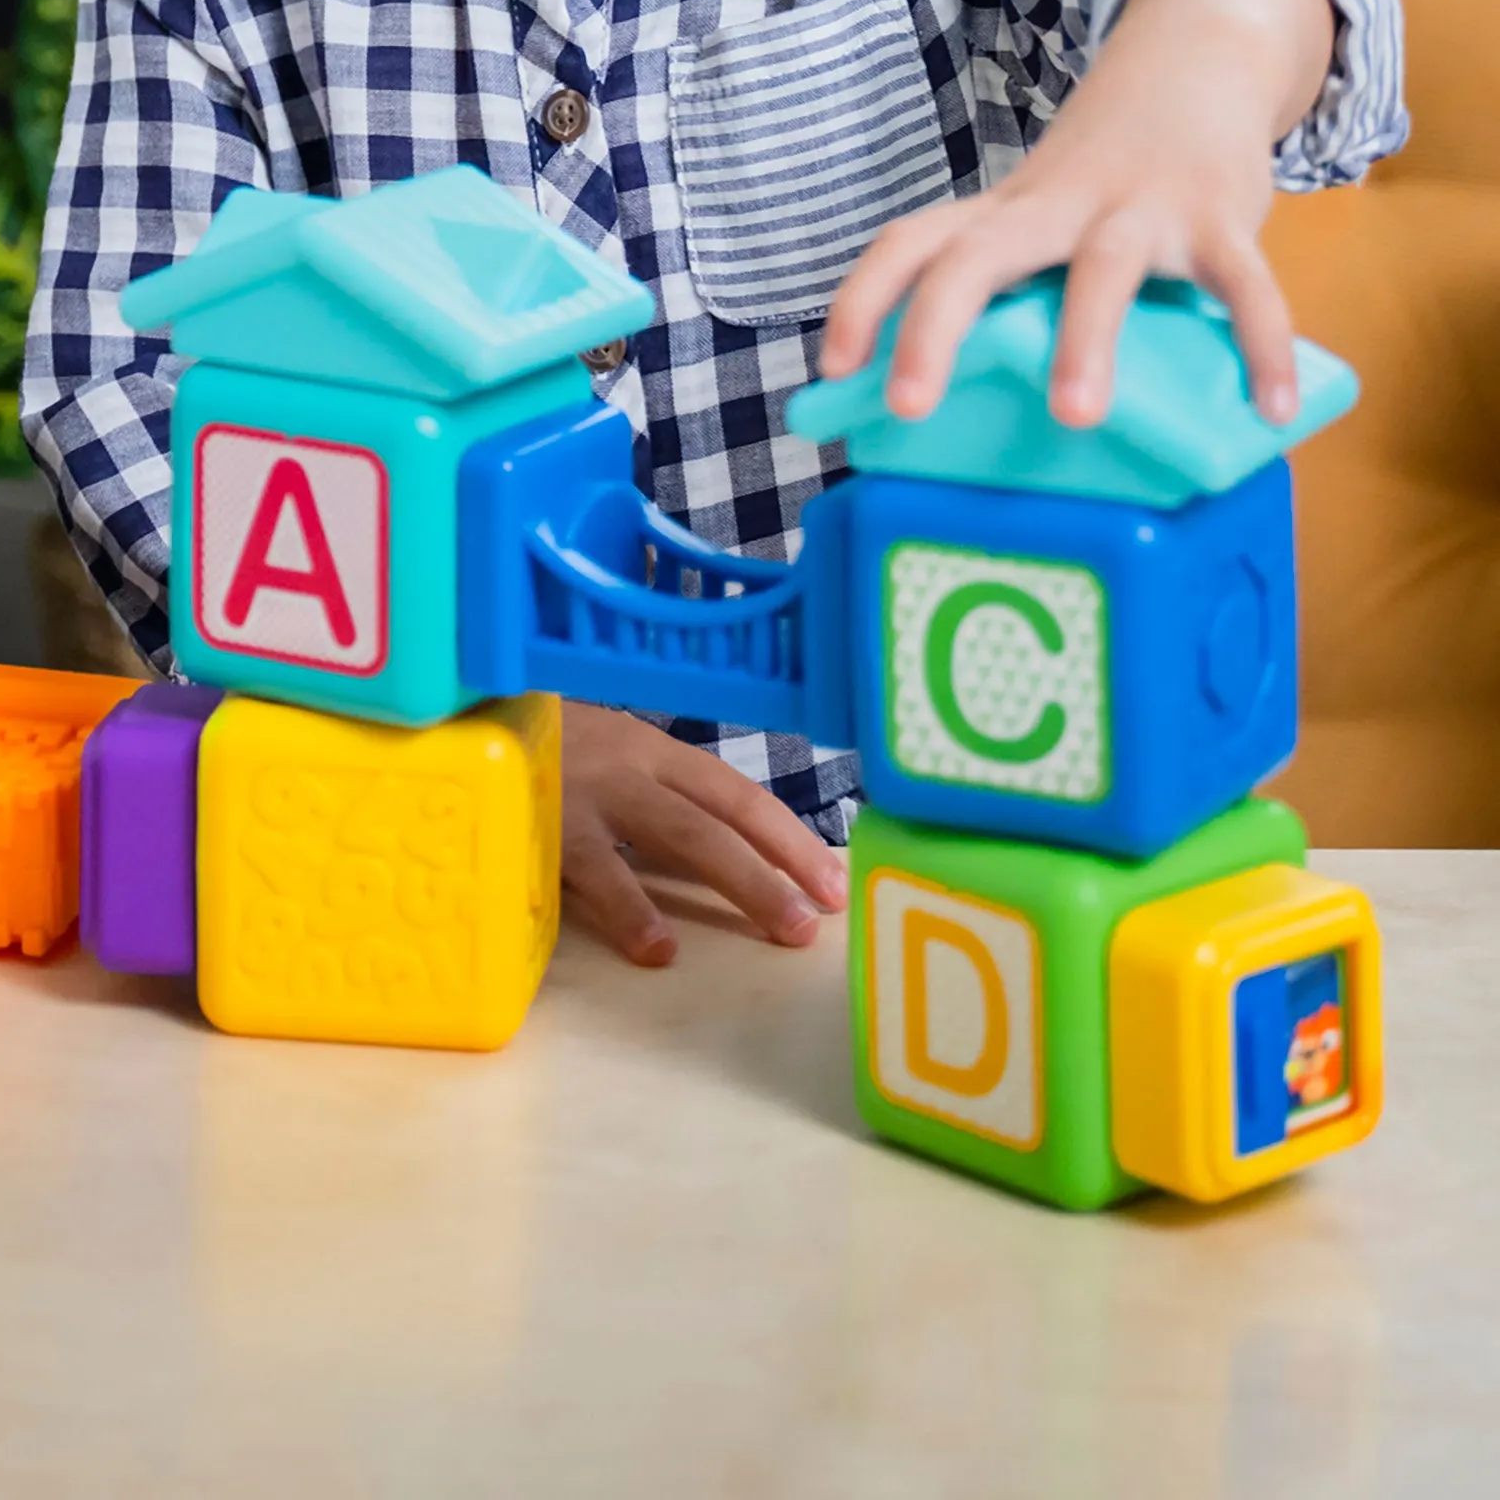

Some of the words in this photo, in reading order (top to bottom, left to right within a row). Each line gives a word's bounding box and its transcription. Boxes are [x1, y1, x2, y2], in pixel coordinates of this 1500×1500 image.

[223, 457, 356, 648] A
[926, 582, 1066, 763] C
[902, 908, 1008, 1098] D
